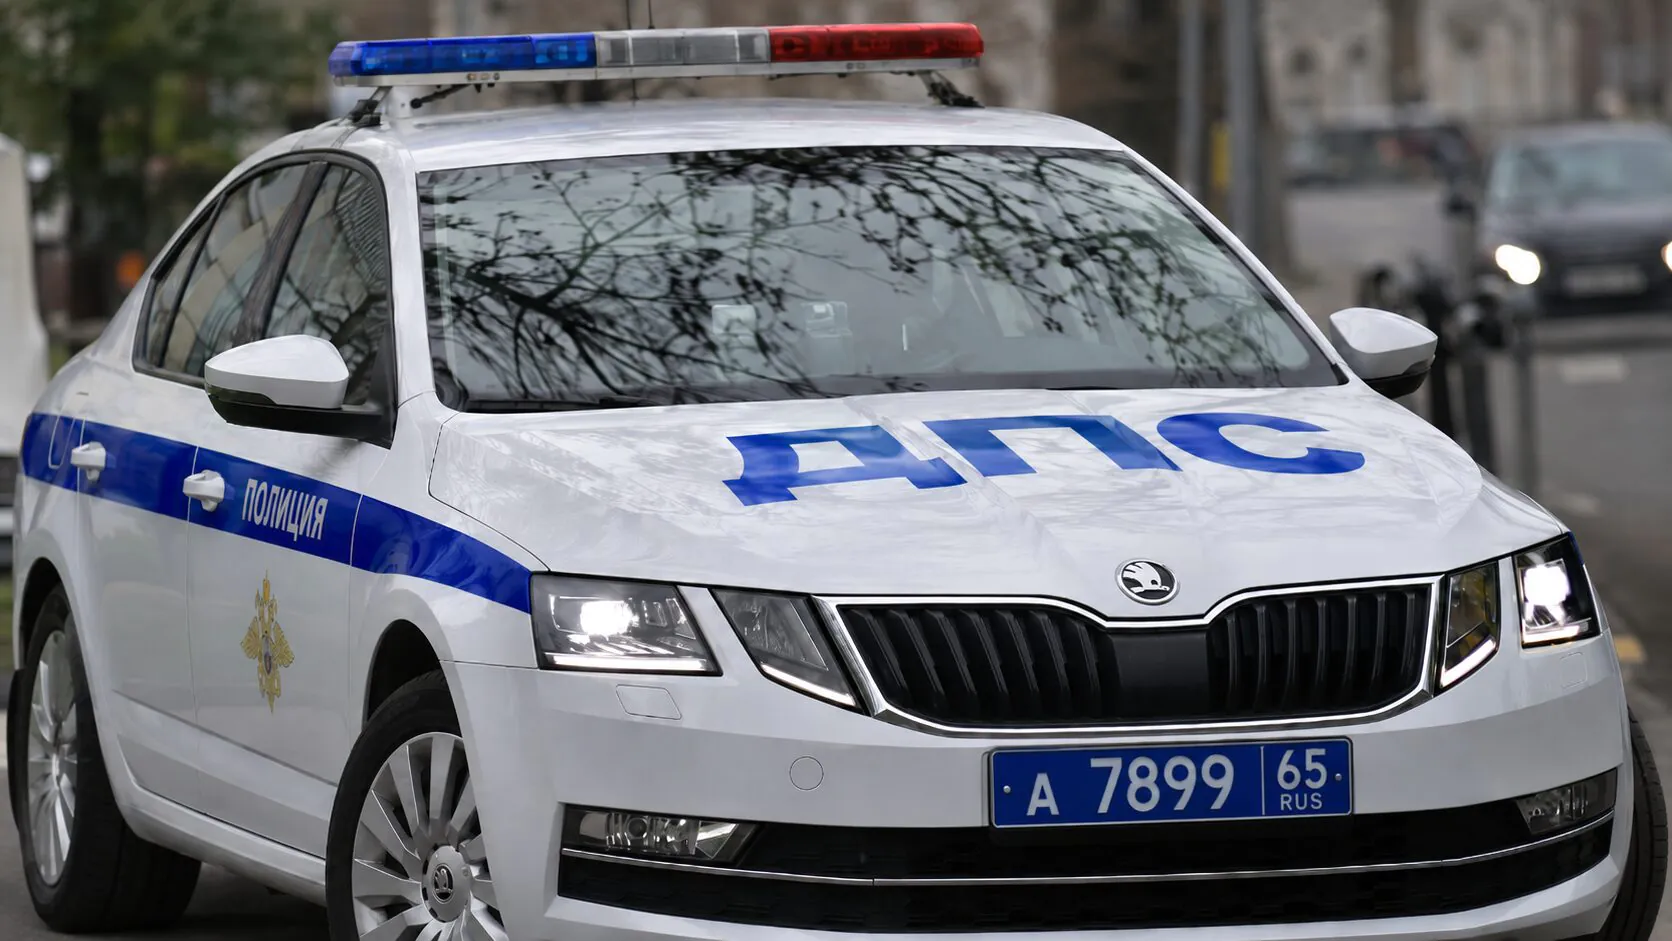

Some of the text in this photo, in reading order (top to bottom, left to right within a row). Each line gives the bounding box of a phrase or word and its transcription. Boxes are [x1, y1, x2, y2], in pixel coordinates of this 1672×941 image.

[722, 412, 1365, 506] ДПС
[243, 478, 328, 541] ПОЛИЦИЯ
[1090, 754, 1234, 813] 7899
[1277, 748, 1328, 789] 65
[1280, 792, 1323, 811] RUS
